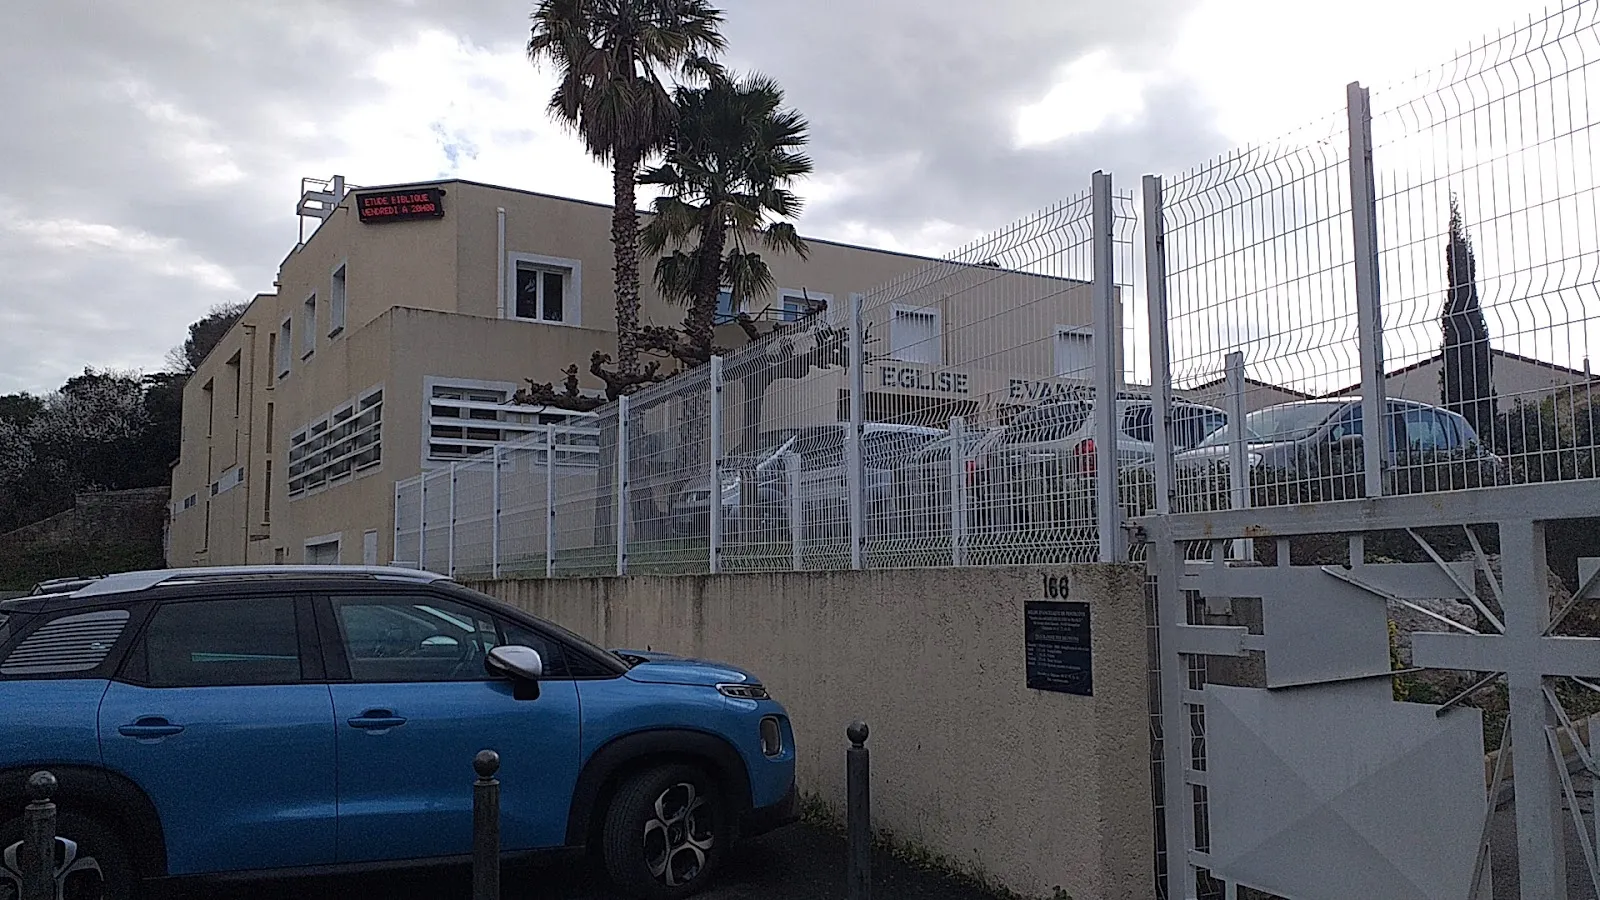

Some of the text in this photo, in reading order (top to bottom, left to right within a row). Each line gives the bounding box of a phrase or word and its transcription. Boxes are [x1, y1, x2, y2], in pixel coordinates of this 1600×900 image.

[365, 194, 429, 206] ETUDE BIBLIQUE
[362, 206, 398, 216] VENDREDI
[402, 205, 408, 213] A
[880, 366, 968, 393] EGLISE
[1041, 573, 1069, 599] 166
